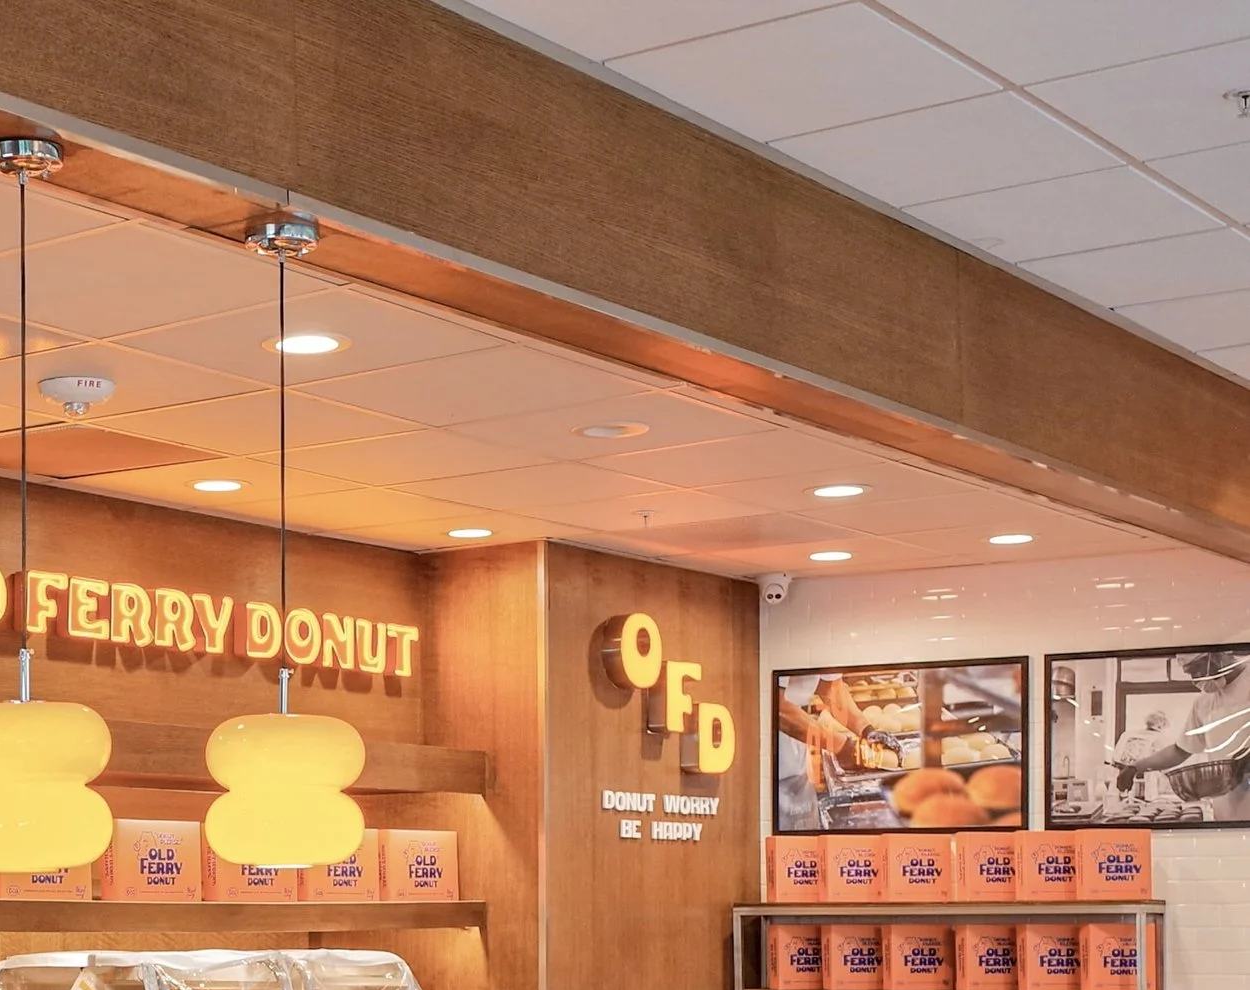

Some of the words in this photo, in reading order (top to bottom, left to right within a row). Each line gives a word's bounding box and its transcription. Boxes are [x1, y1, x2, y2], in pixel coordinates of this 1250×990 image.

[77, 380, 102, 388] FIRE
[27, 570, 234, 654] FERRY
[246, 601, 418, 677] DONUT
[603, 790, 656, 812] DONUT
[663, 795, 719, 816] WORRY
[620, 819, 642, 839] BE
[651, 821, 703, 841] HAPPY
[148, 848, 175, 860] OLD
[1106, 854, 1134, 863] OLD
[415, 855, 436, 866] OLD
[794, 860, 817, 869] OLD
[847, 859, 872, 868] OLD
[910, 858, 935, 867] OLD
[987, 857, 1011, 865] OLD
[1046, 856, 1072, 865] OLD
[140, 858, 183, 874] FERRY
[327, 865, 364, 877] FERRY
[408, 864, 444, 878] FERRY
[902, 865, 943, 877] FERRY
[1098, 862, 1142, 874] FERRY
[787, 867, 819, 878] FERR
[840, 866, 879, 878] FERRY
[31, 874, 64, 885] DONUT
[147, 876, 176, 885] DONUT
[247, 878, 275, 886] DONUT
[333, 878, 359, 887] DONUT
[414, 879, 438, 888] DONUT
[908, 877, 937, 885] DONUT
[797, 947, 820, 957] OLD
[851, 947, 876, 957] OLD
[911, 948, 937, 957] OLD
[986, 948, 1011, 957] OLD
[1048, 949, 1075, 957] OLD
[1111, 949, 1137, 957] OLD
[843, 955, 883, 966] FERRY
[904, 955, 944, 966] FERRY
[978, 956, 1017, 967] FERRY
[1103, 956, 1137, 968] FERR
[910, 966, 938, 974] DONUT
